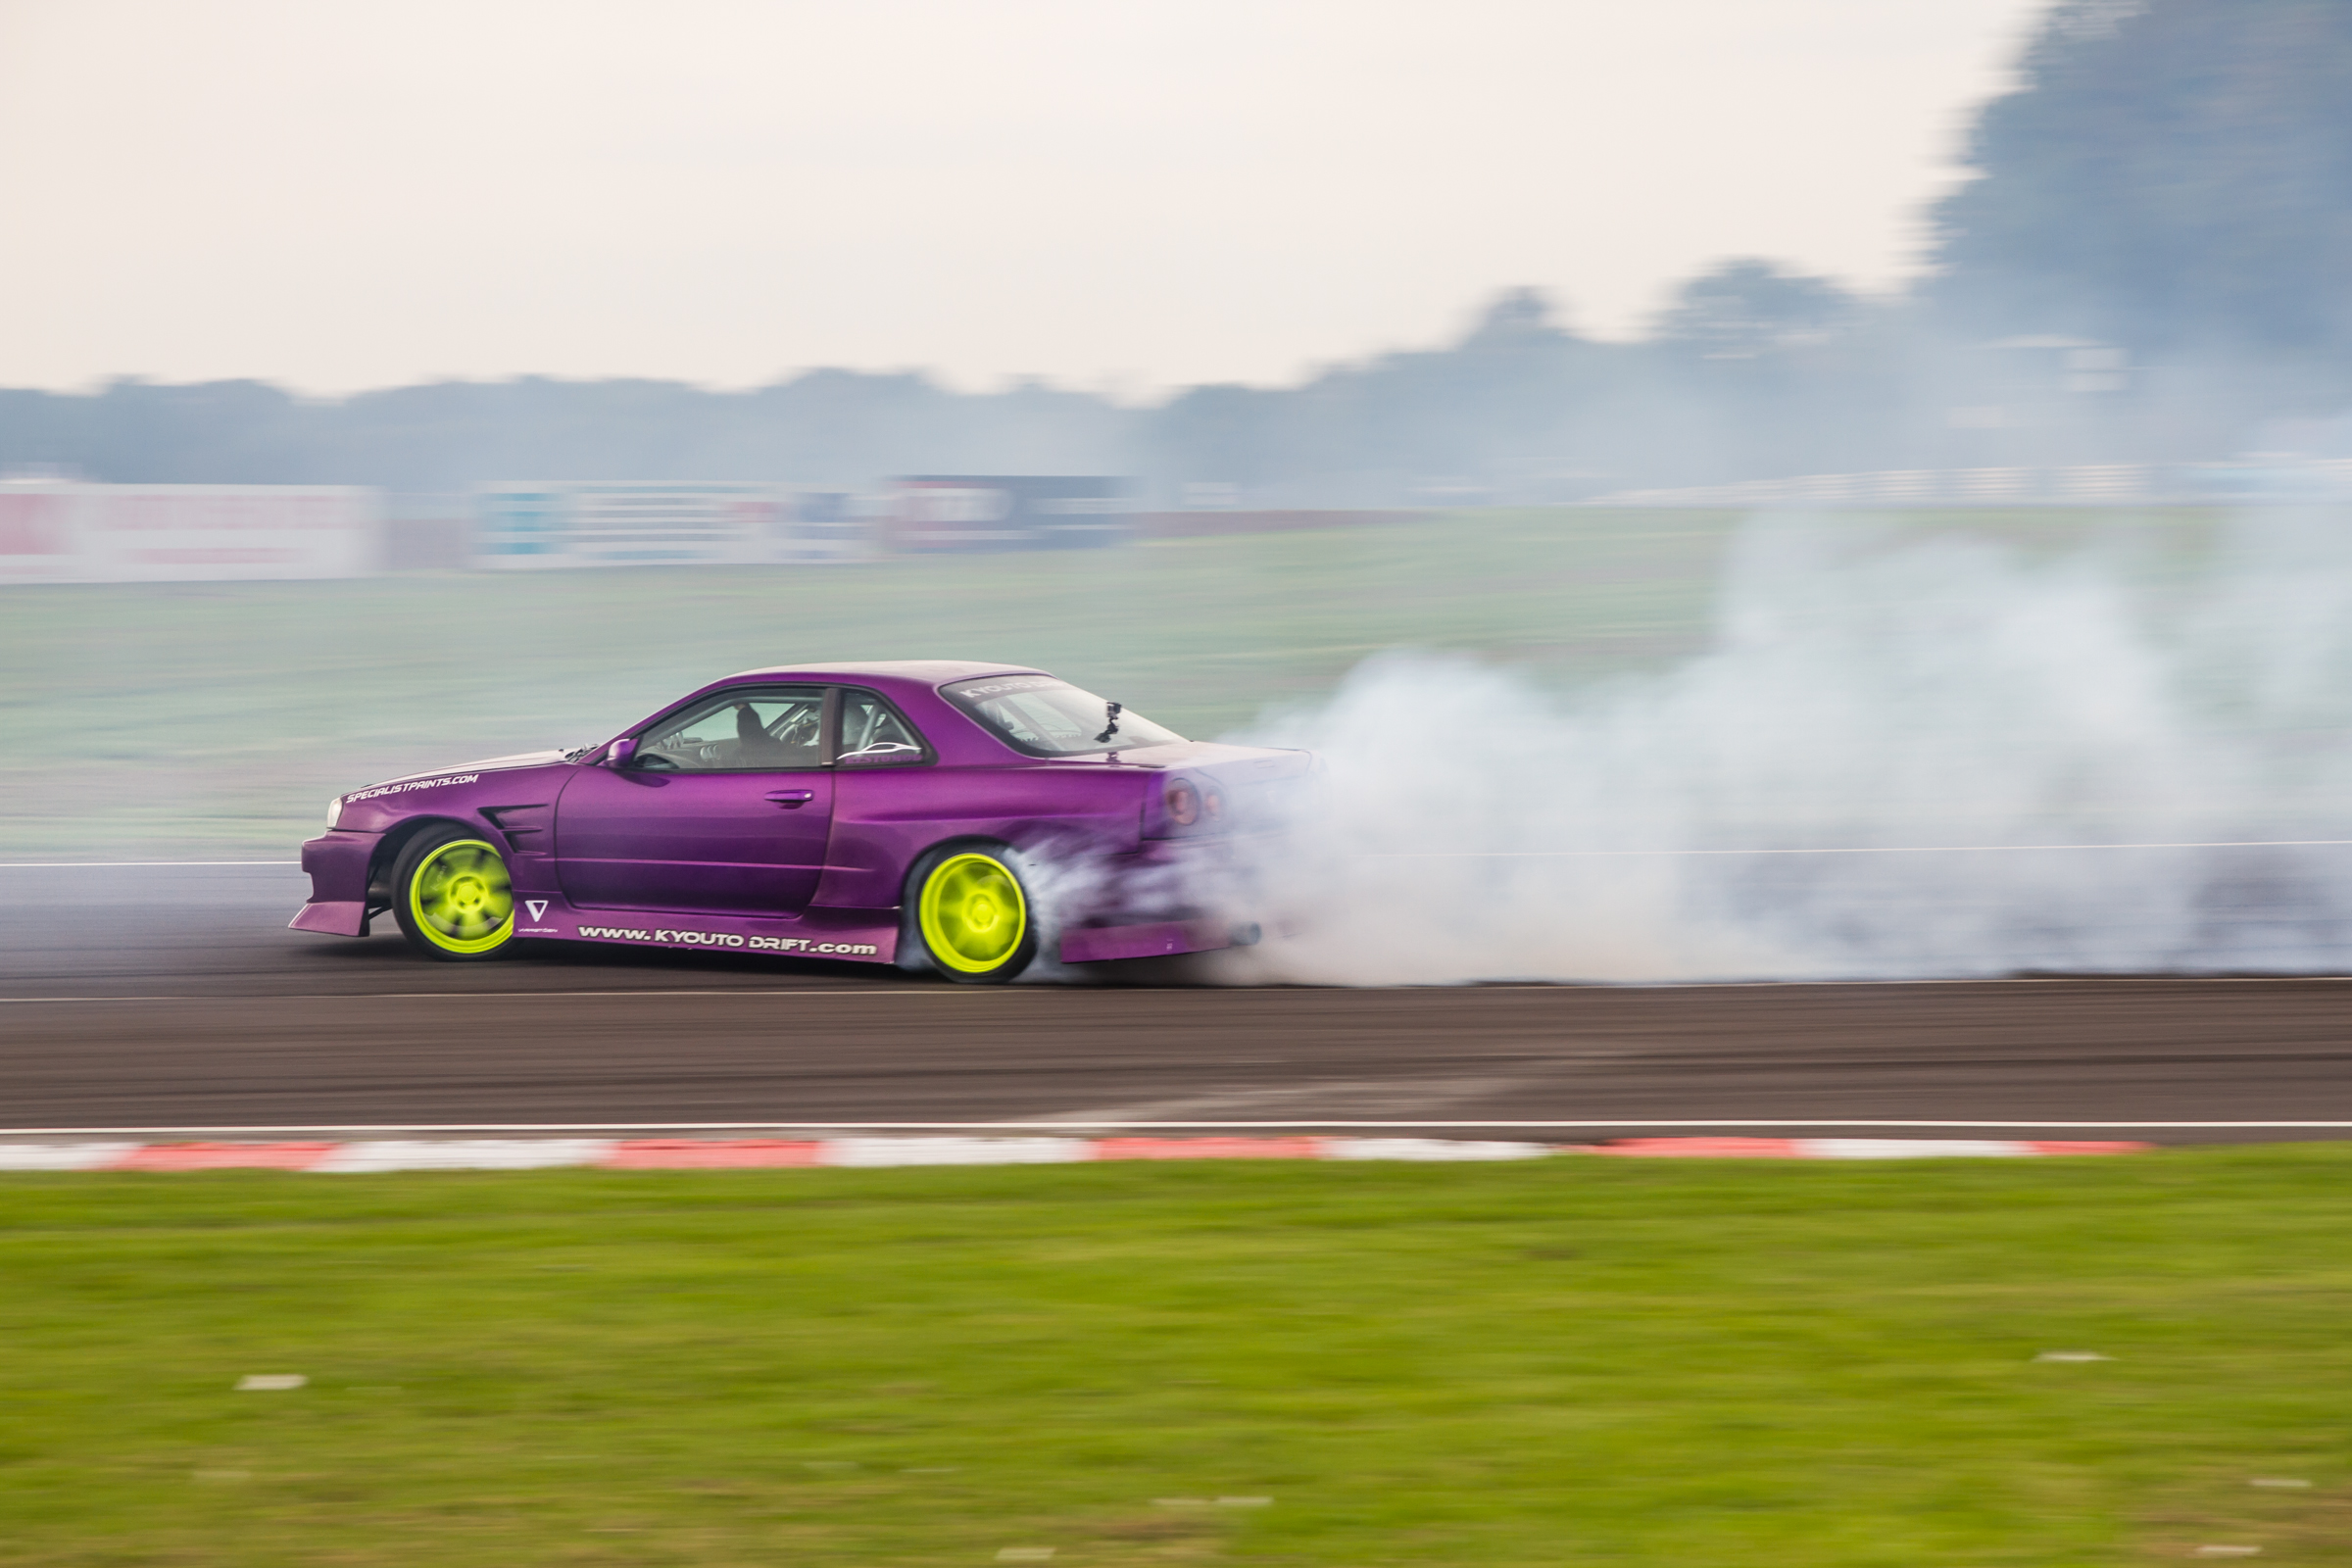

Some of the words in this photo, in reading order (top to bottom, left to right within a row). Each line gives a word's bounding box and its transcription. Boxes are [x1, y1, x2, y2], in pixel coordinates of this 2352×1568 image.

[960, 682, 1032, 698] KYOUTO
[346, 774, 479, 804] SPECIALISTPAINTS.COM
[654, 929, 745, 947] KYOUTO
[748, 936, 877, 955] DRIFT.com
